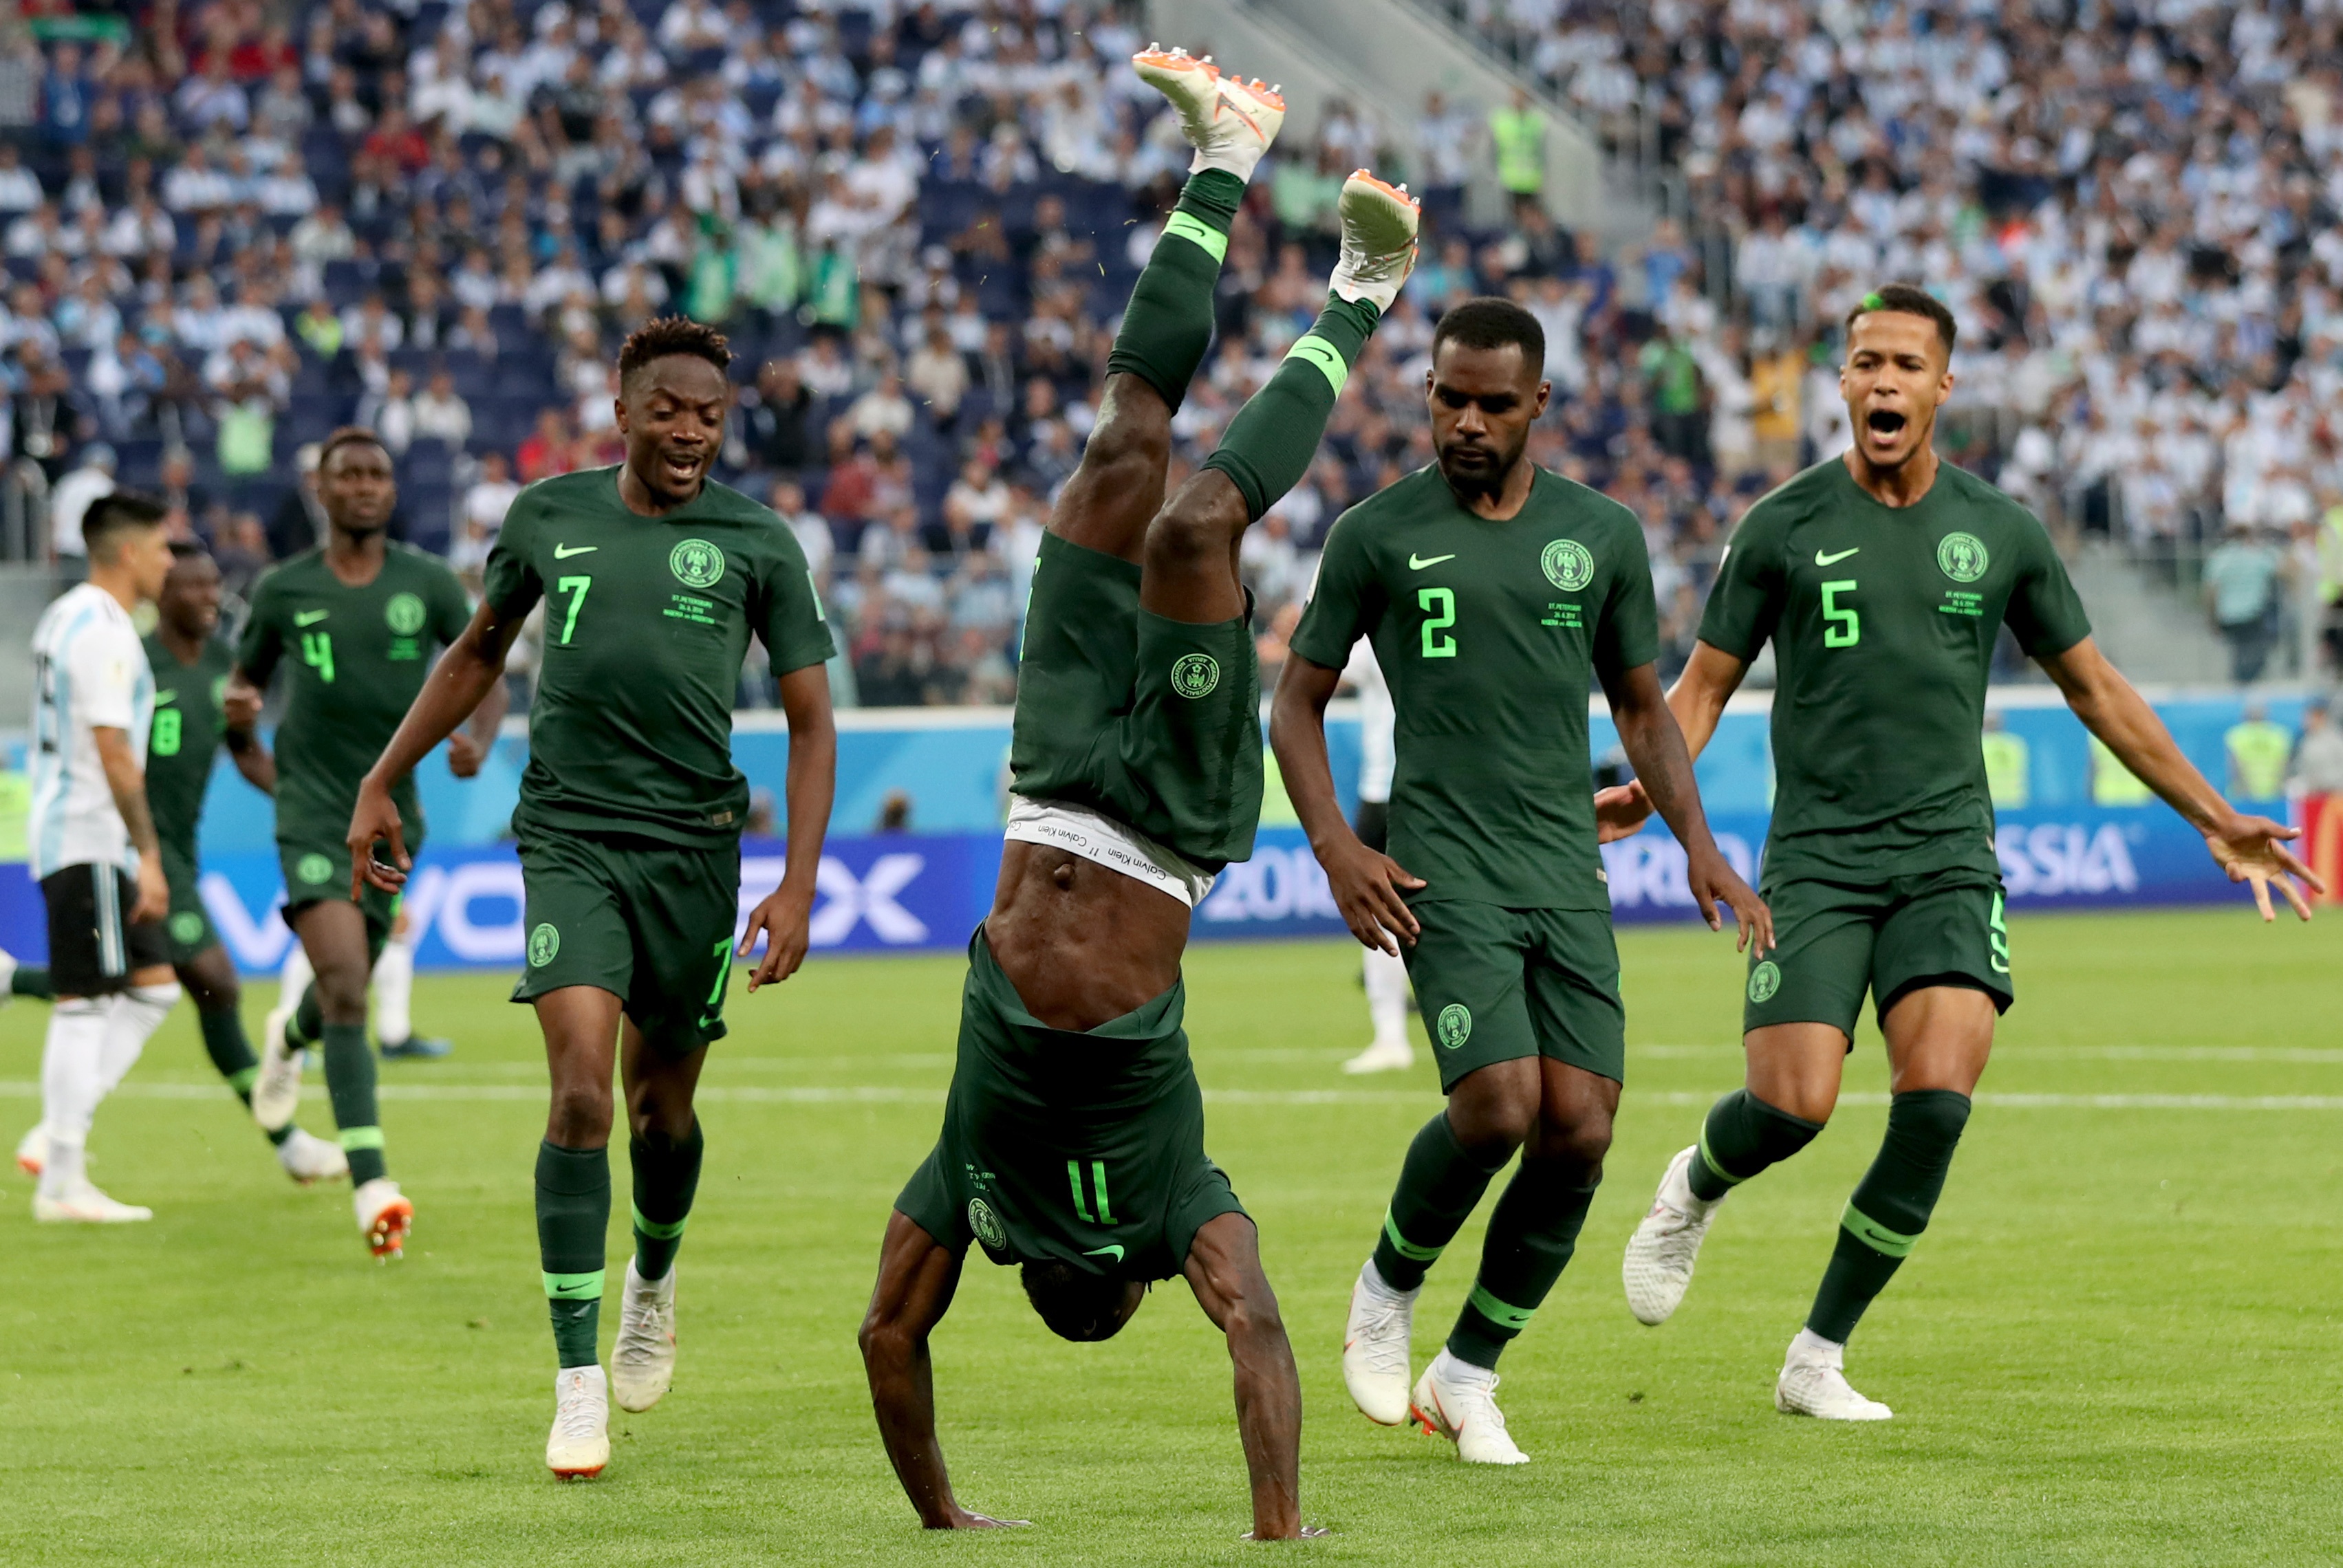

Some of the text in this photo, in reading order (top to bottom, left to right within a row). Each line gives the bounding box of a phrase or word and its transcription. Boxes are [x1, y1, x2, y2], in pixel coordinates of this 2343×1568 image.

[559, 576, 592, 644] 7
[1418, 587, 1456, 657] 2
[1821, 579, 1859, 648] 5
[301, 631, 336, 683] 4
[152, 706, 182, 757] 8
[1037, 824, 1057, 837] Klein
[1058, 829, 1087, 847] Calvin
[1108, 847, 1167, 881] Calvin Klein
[706, 935, 733, 1004] 7
[1067, 1159, 1118, 1225] 11
